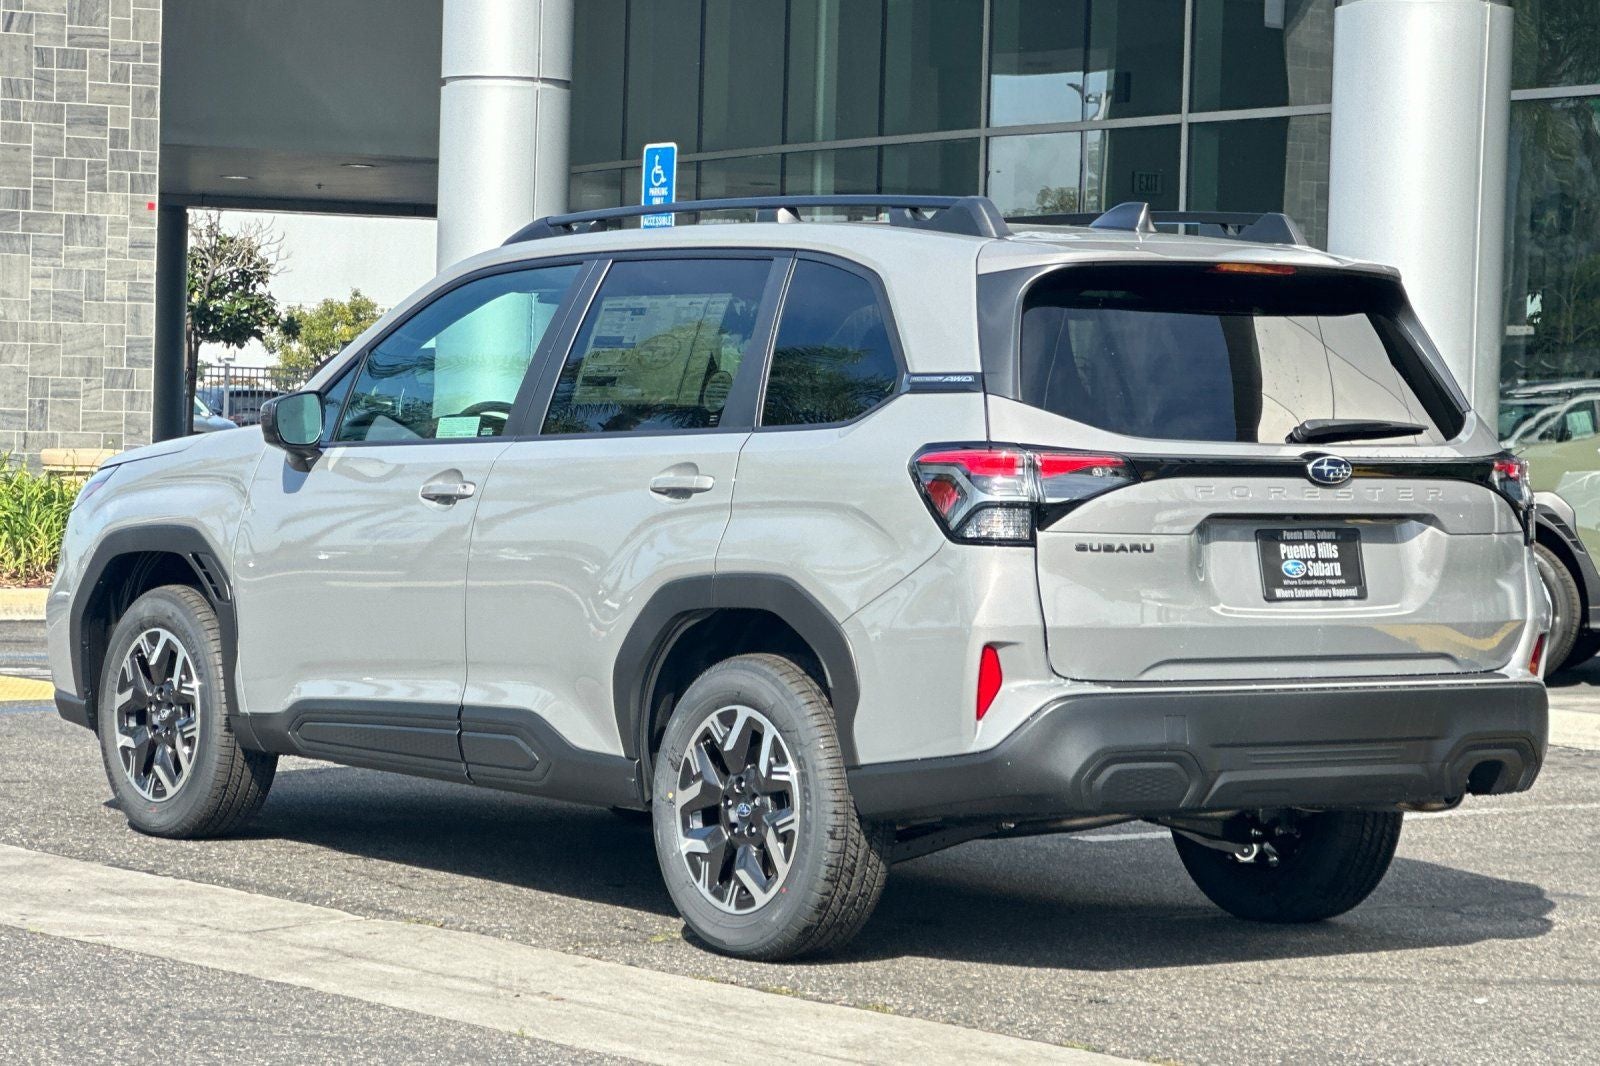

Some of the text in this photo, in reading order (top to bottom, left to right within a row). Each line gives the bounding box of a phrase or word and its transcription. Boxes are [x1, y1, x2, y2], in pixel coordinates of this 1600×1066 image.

[1138, 173, 1159, 192] EXIT
[648, 187, 668, 196] PARKING
[643, 215, 672, 226] ACCESSIBLE
[1194, 484, 1444, 501] FORESTER
[1282, 530, 1336, 540] Puente Hills Subaru
[1075, 542, 1155, 553] SUBARU
[1280, 542, 1339, 559] Puente Hills
[1307, 561, 1342, 576] Subaru
[1275, 588, 1294, 598] Where
[1294, 587, 1331, 598] Extraordinary
